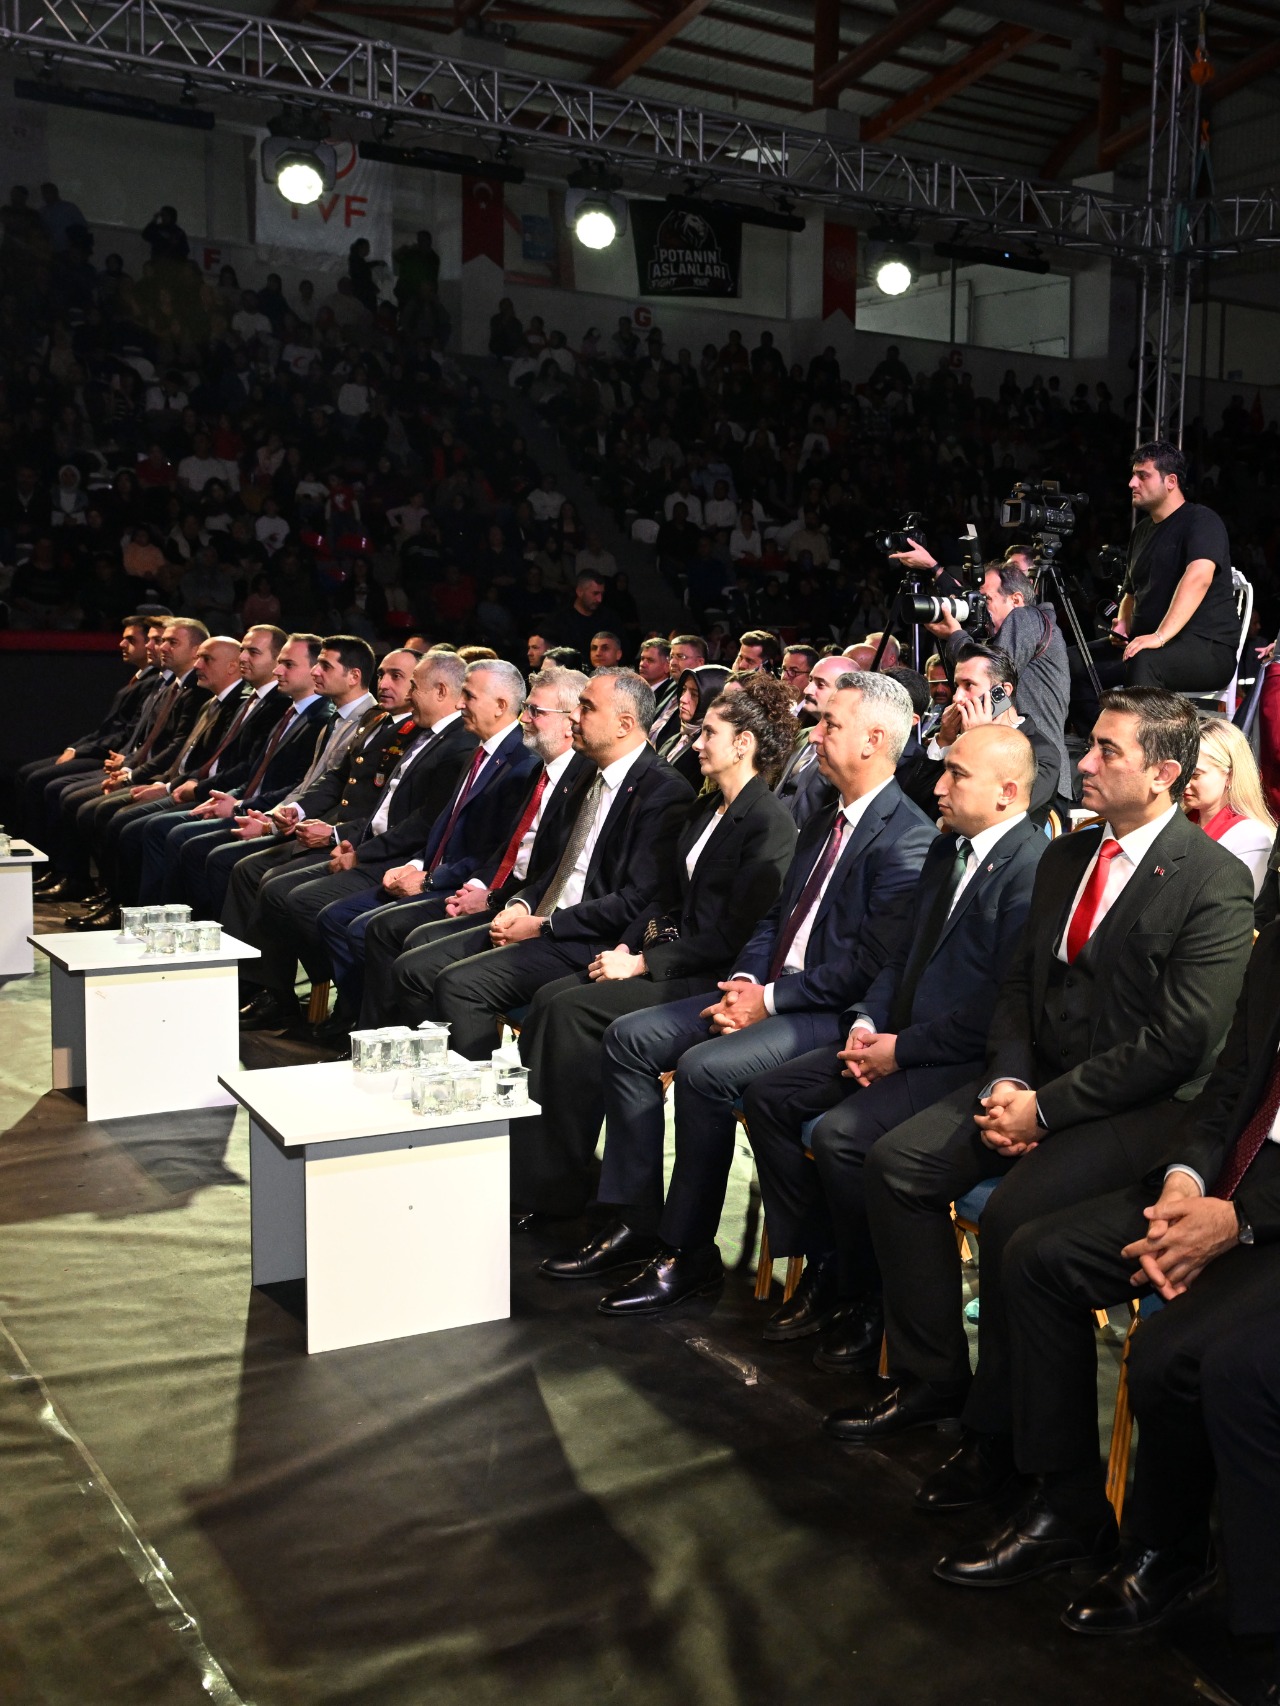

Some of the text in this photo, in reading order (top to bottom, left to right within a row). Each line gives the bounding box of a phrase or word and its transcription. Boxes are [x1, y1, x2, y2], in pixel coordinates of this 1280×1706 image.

[204, 248, 221, 270] F
[659, 249, 717, 264] POTANIN
[652, 262, 726, 280] ASLANLARI
[634, 307, 652, 327] G
[949, 350, 963, 368] G
